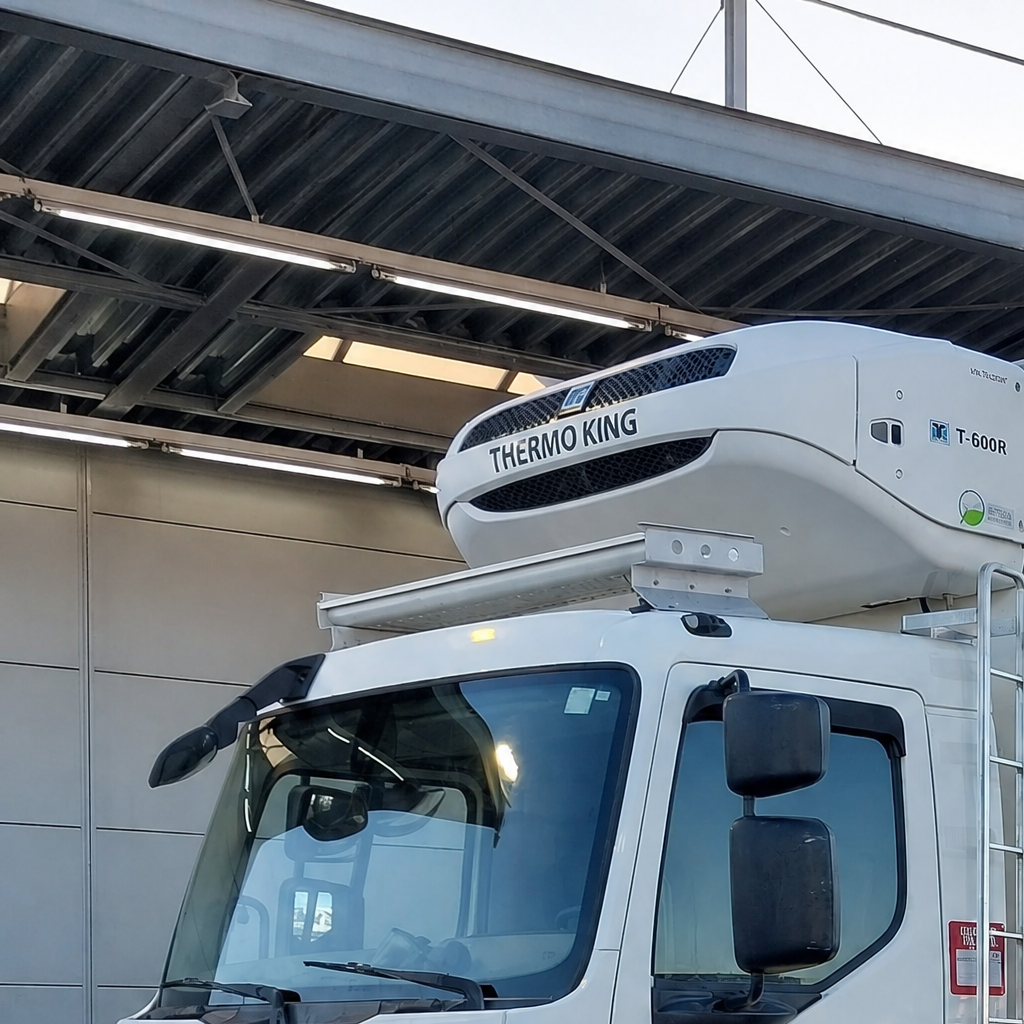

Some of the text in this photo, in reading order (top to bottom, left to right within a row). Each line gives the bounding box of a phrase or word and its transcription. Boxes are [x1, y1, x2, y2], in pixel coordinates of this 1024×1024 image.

[489, 407, 638, 473] THERMO KING
[955, 427, 1007, 456] T-600R
